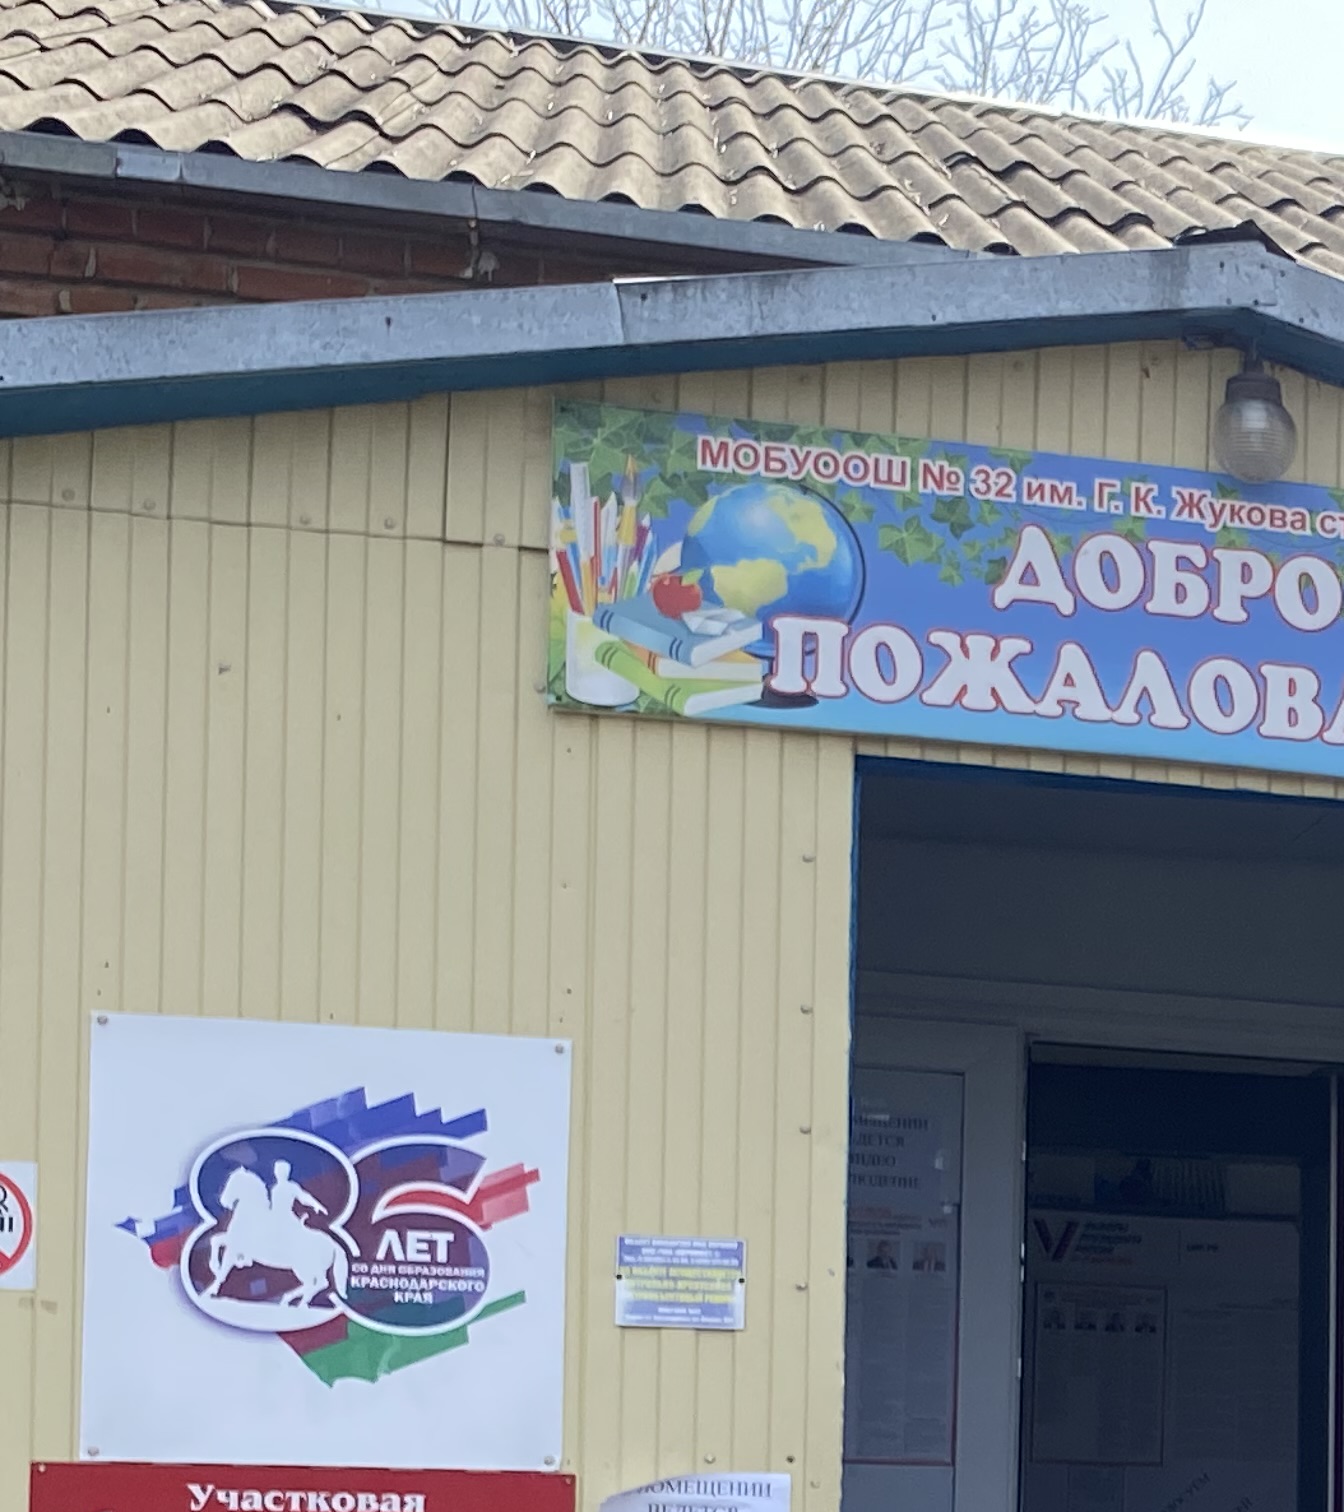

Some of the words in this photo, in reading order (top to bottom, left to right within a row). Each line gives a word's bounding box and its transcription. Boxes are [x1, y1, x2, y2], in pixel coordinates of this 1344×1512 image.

[700, 436, 907, 489] МОБУООШ
[922, 461, 962, 492] №
[973, 467, 1015, 498] 32
[1024, 479, 1085, 508] им.
[1095, 480, 1123, 512] Г.
[1131, 483, 1164, 515] К.
[1172, 487, 1308, 533] Жукова
[994, 524, 1343, 631] ДОБРО
[376, 1229, 455, 1263] ЛЕТ
[350, 1276, 485, 1292] КРАСНОДАРСКОГО
[398, 1265, 485, 1278] ОБРАЗОВАНИЯ
[394, 1291, 433, 1304] КРАЯ
